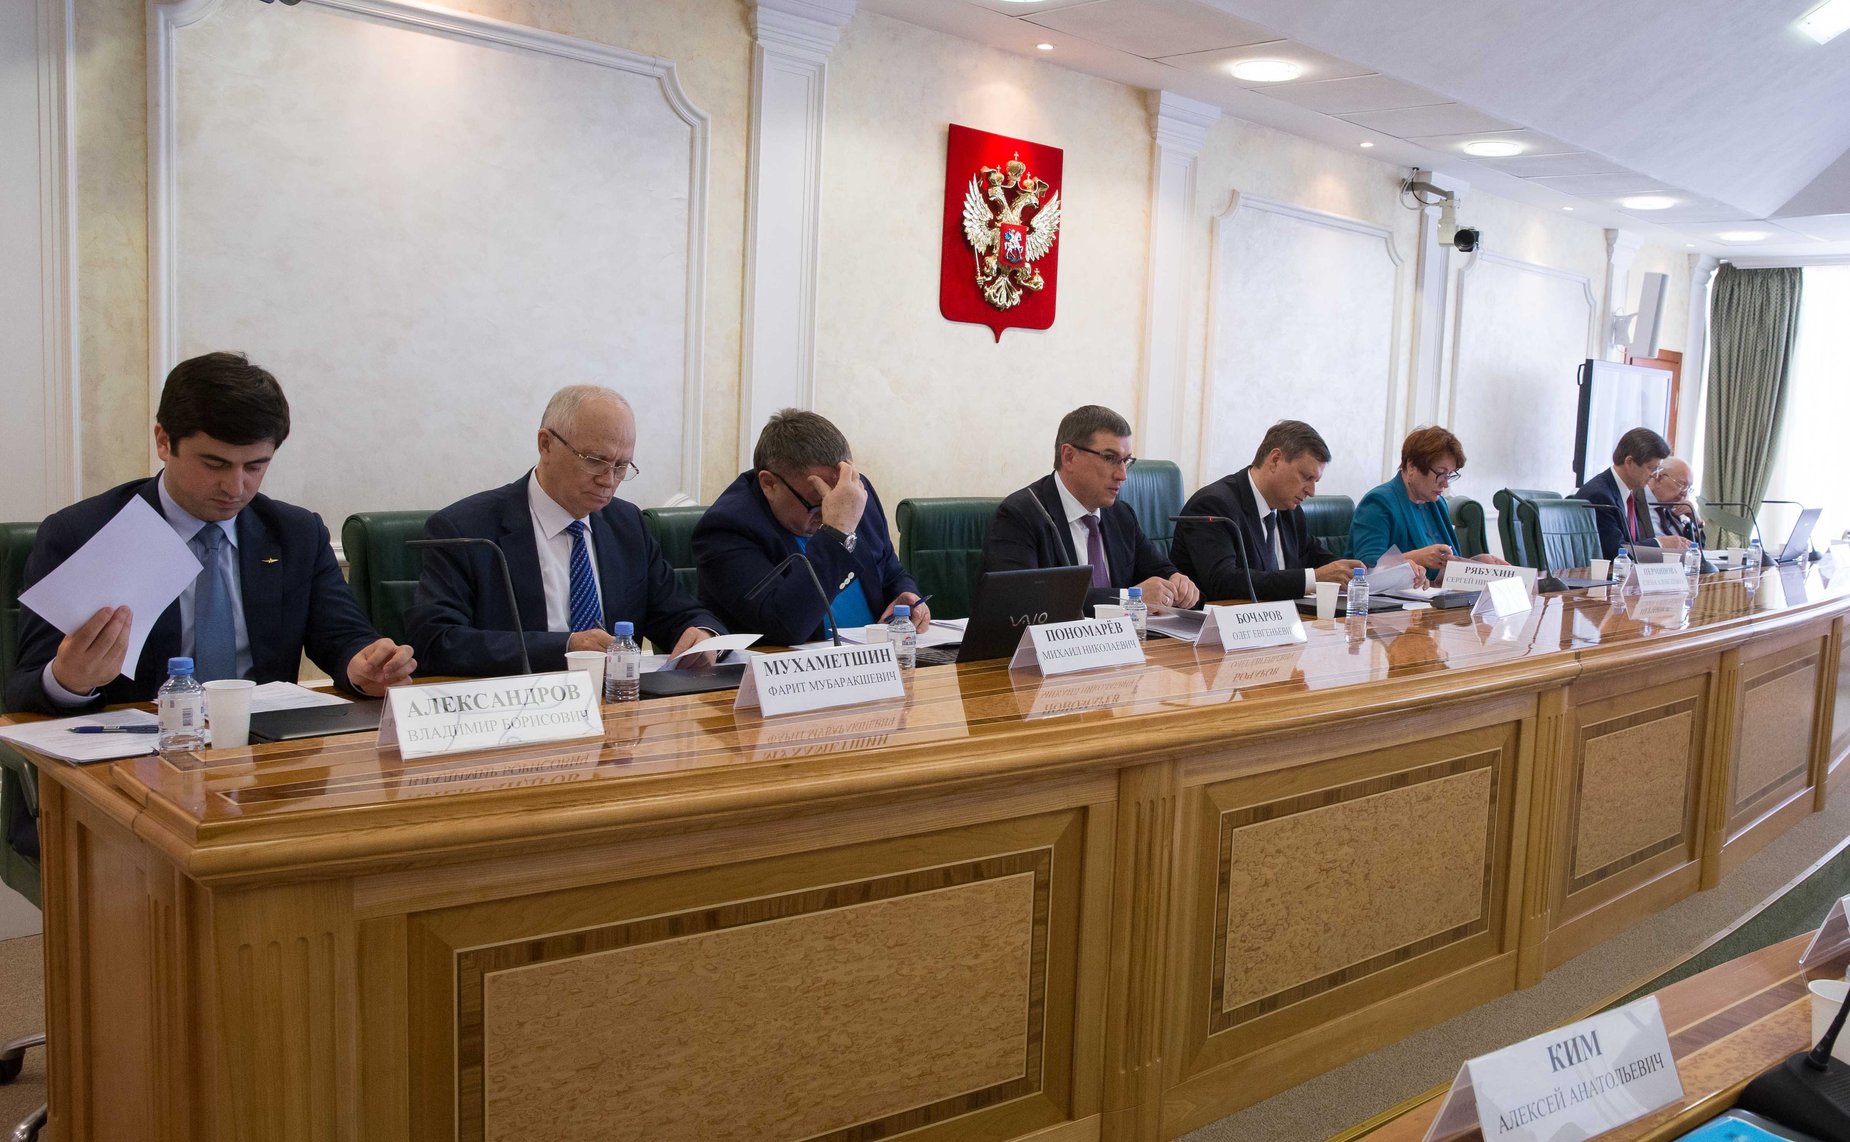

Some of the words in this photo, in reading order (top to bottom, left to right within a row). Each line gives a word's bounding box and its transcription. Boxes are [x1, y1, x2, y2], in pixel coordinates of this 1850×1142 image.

[1464, 566, 1515, 578] РЯБУХИН
[1009, 612, 1048, 627] VAIO
[1235, 610, 1283, 625] БОЧАРОВ
[1045, 620, 1124, 642] ПОНОМАРЁВ
[1232, 630, 1252, 641] ОЛЕГ
[1253, 626, 1293, 638] ЕВГЕНЬЕВИ
[1042, 648, 1082, 661] МИХАИЛ
[1082, 639, 1137, 655] НИКОЛАЕВИЧ
[763, 648, 892, 677] МУХАМЕТШИН
[768, 681, 807, 697] ФАРИТ
[809, 672, 897, 690] МУБАРАКШЕВИЧ
[407, 684, 581, 718] АЛЕКСАНДРОВ
[407, 720, 498, 743] ВЛАДИМИР
[502, 709, 590, 731] БОРИСОВИЧ
[1546, 1030, 1602, 1073] КИМ
[1498, 1087, 1566, 1135] АЛЕКСЕЙ
[1568, 1053, 1664, 1106] АНАТОЛЬЕВИЧ
